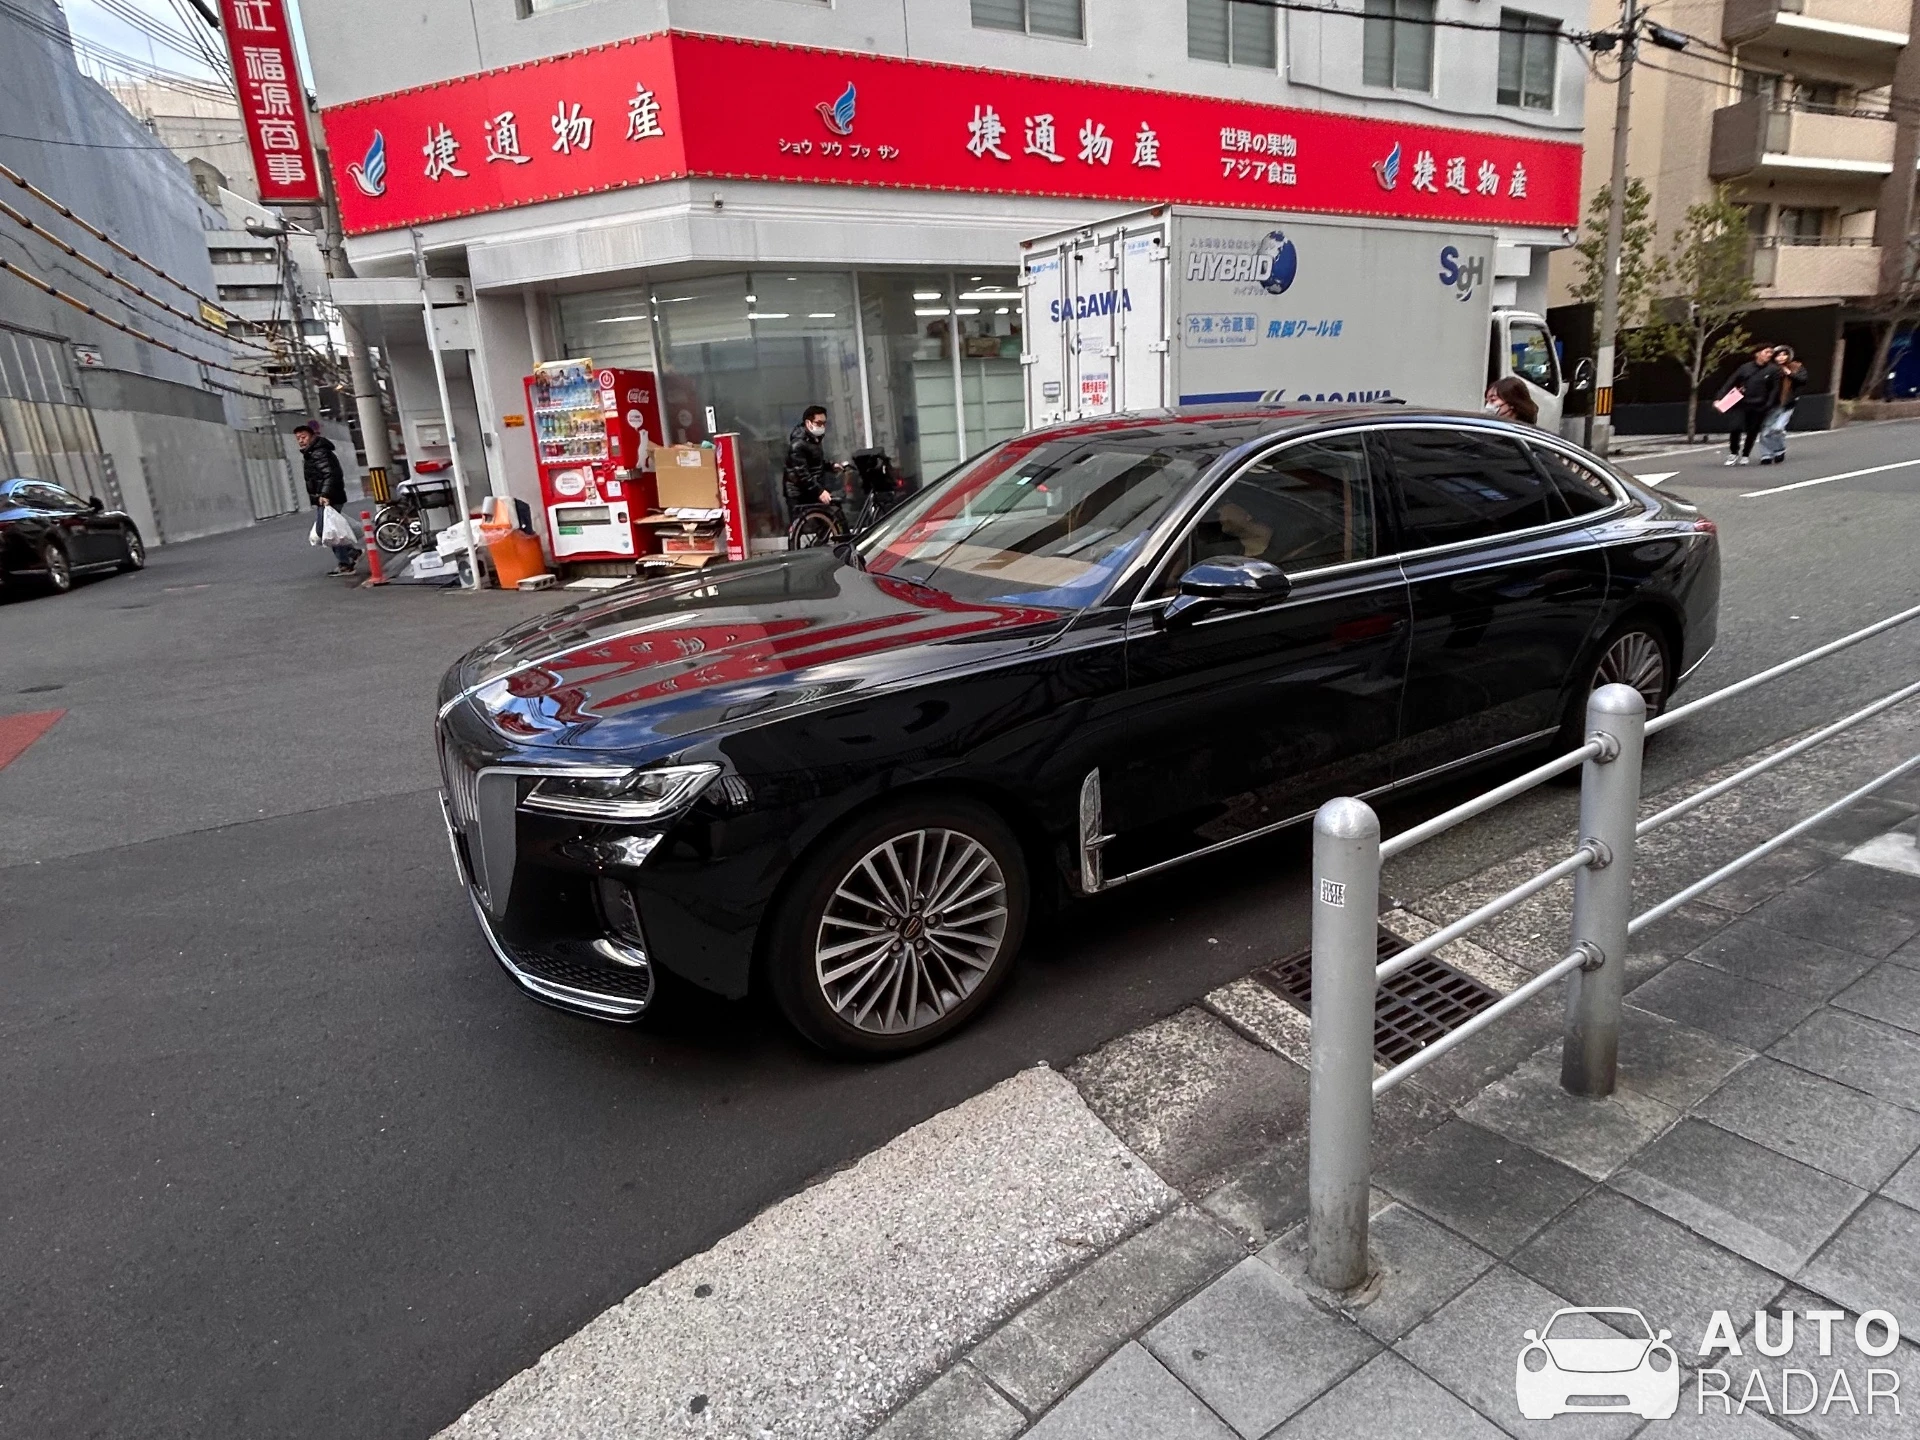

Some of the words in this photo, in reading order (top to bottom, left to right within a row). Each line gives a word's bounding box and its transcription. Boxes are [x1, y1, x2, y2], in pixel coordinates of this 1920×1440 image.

[243, 46, 307, 185] 福源商事
[422, 82, 665, 182] 捷通物産
[966, 104, 1163, 168] 捷通物産
[1220, 127, 1297, 157] 世界の果物
[779, 138, 813, 155] ショウ
[820, 141, 842, 156] ツウ
[877, 145, 900, 159] サン
[1220, 157, 1297, 185] アジア食品
[1412, 149, 1528, 199] 捷通物産
[1186, 252, 1274, 281] HYBRID
[1051, 288, 1132, 322] SAGAWA
[1189, 316, 1255, 333] 冷凍・冷蔵車
